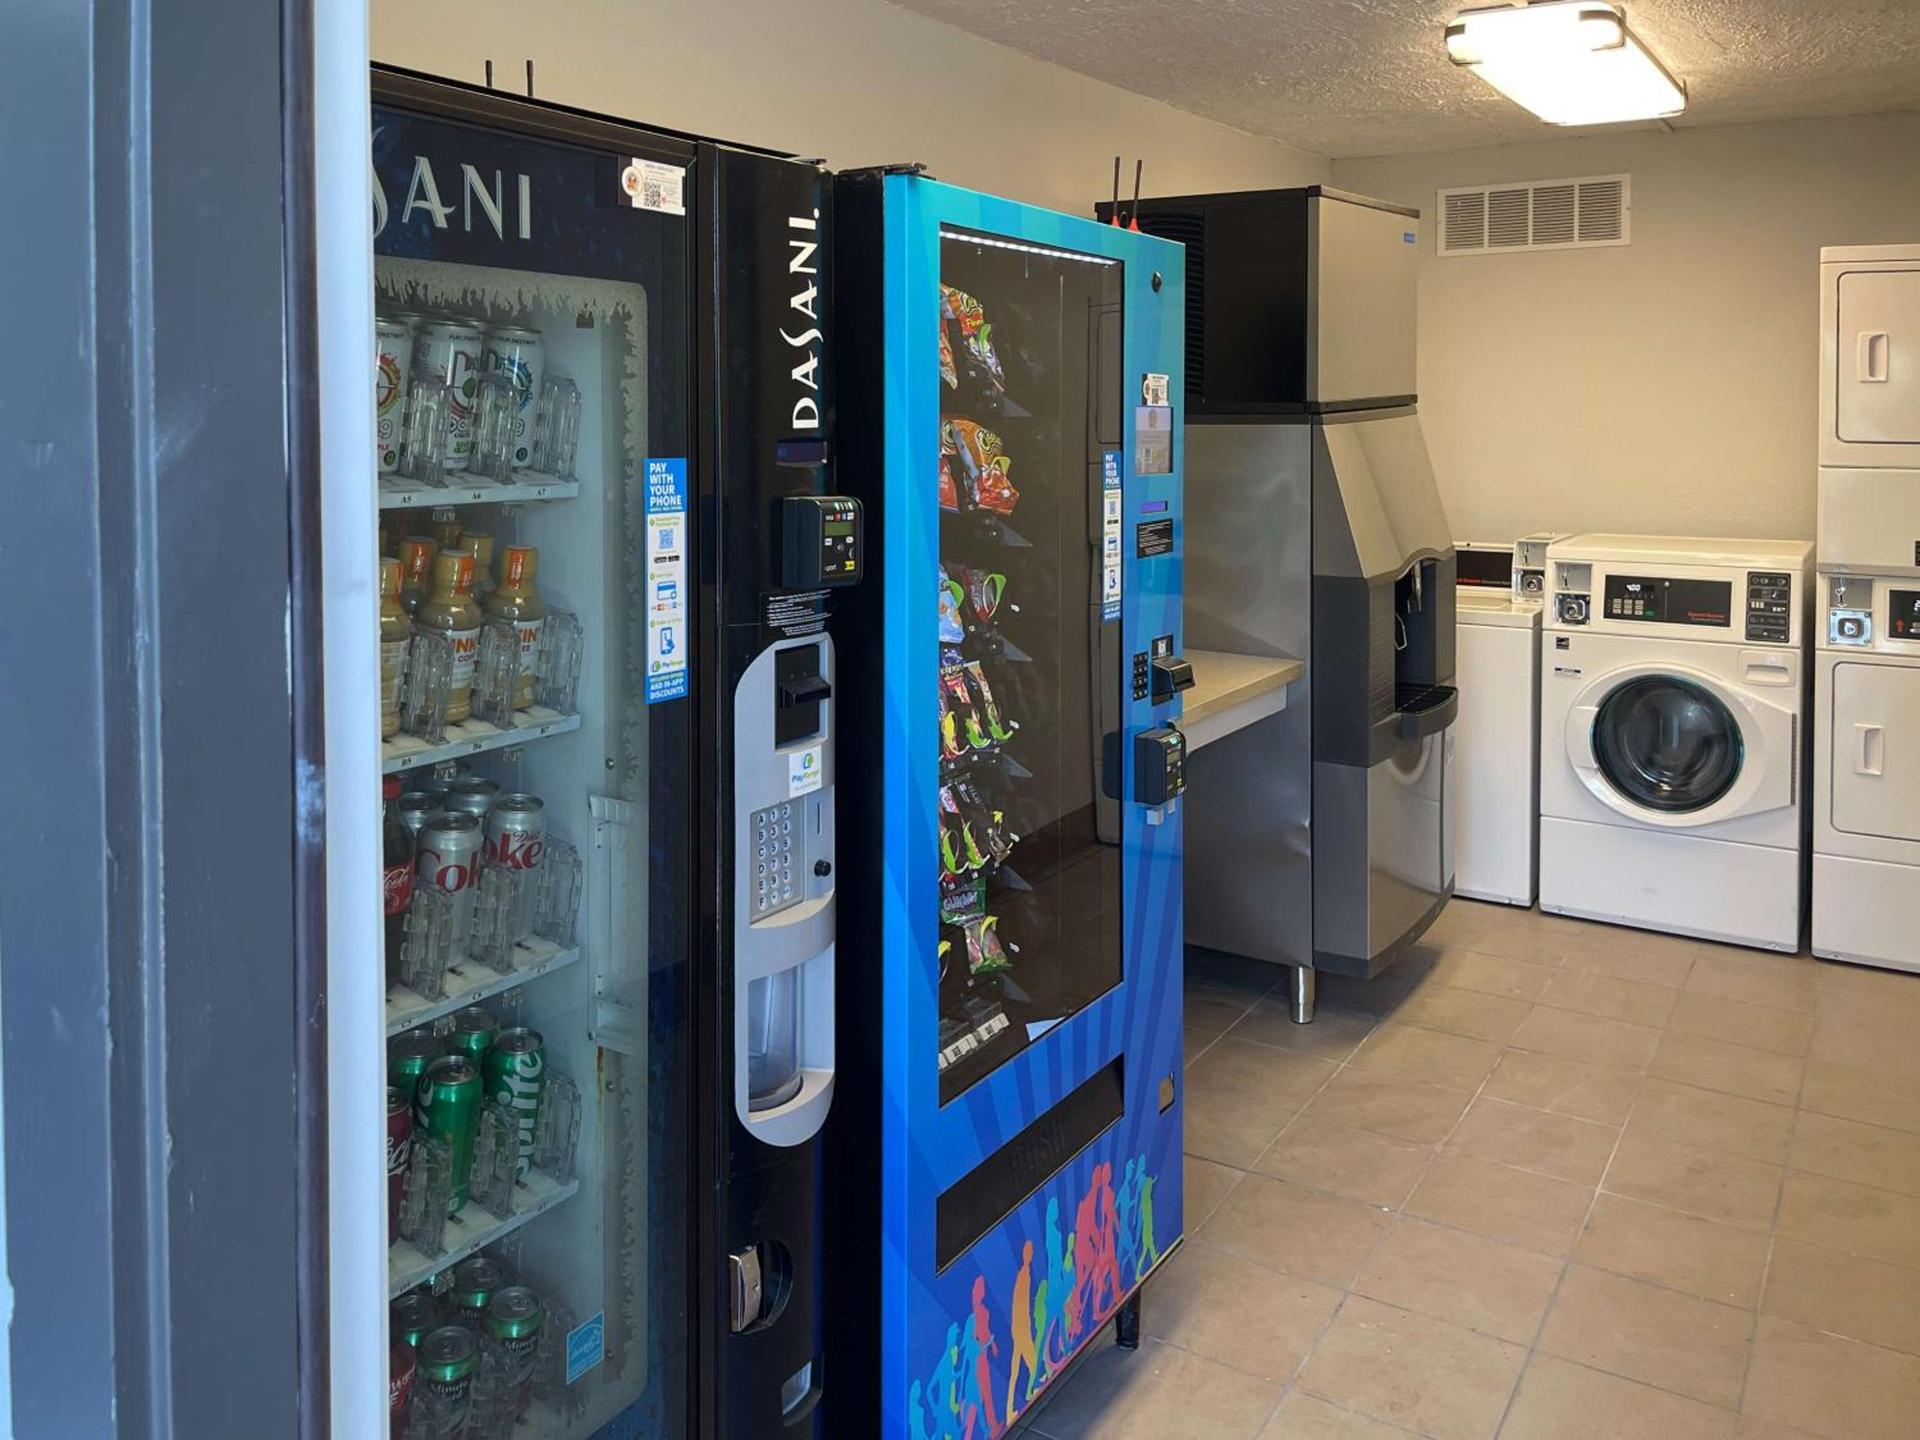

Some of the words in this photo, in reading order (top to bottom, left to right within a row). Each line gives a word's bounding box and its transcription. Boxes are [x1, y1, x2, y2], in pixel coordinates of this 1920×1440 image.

[650, 462, 668, 474] PAY
[650, 473, 674, 485] WITH
[650, 484, 676, 496] YOUR
[650, 495, 683, 507] PHONE
[650, 685, 684, 700] DISCOUNTS
[759, 815, 764, 825] A
[783, 806, 789, 816] 2
[759, 831, 764, 841] B
[771, 827, 776, 837] 3
[783, 823, 788, 832] 4
[759, 848, 764, 858] C
[771, 843, 776, 853] 5
[759, 864, 764, 874] D
[771, 860, 776, 870] 7
[759, 880, 764, 891] E
[771, 876, 776, 885] 9
[759, 897, 764, 907] F
